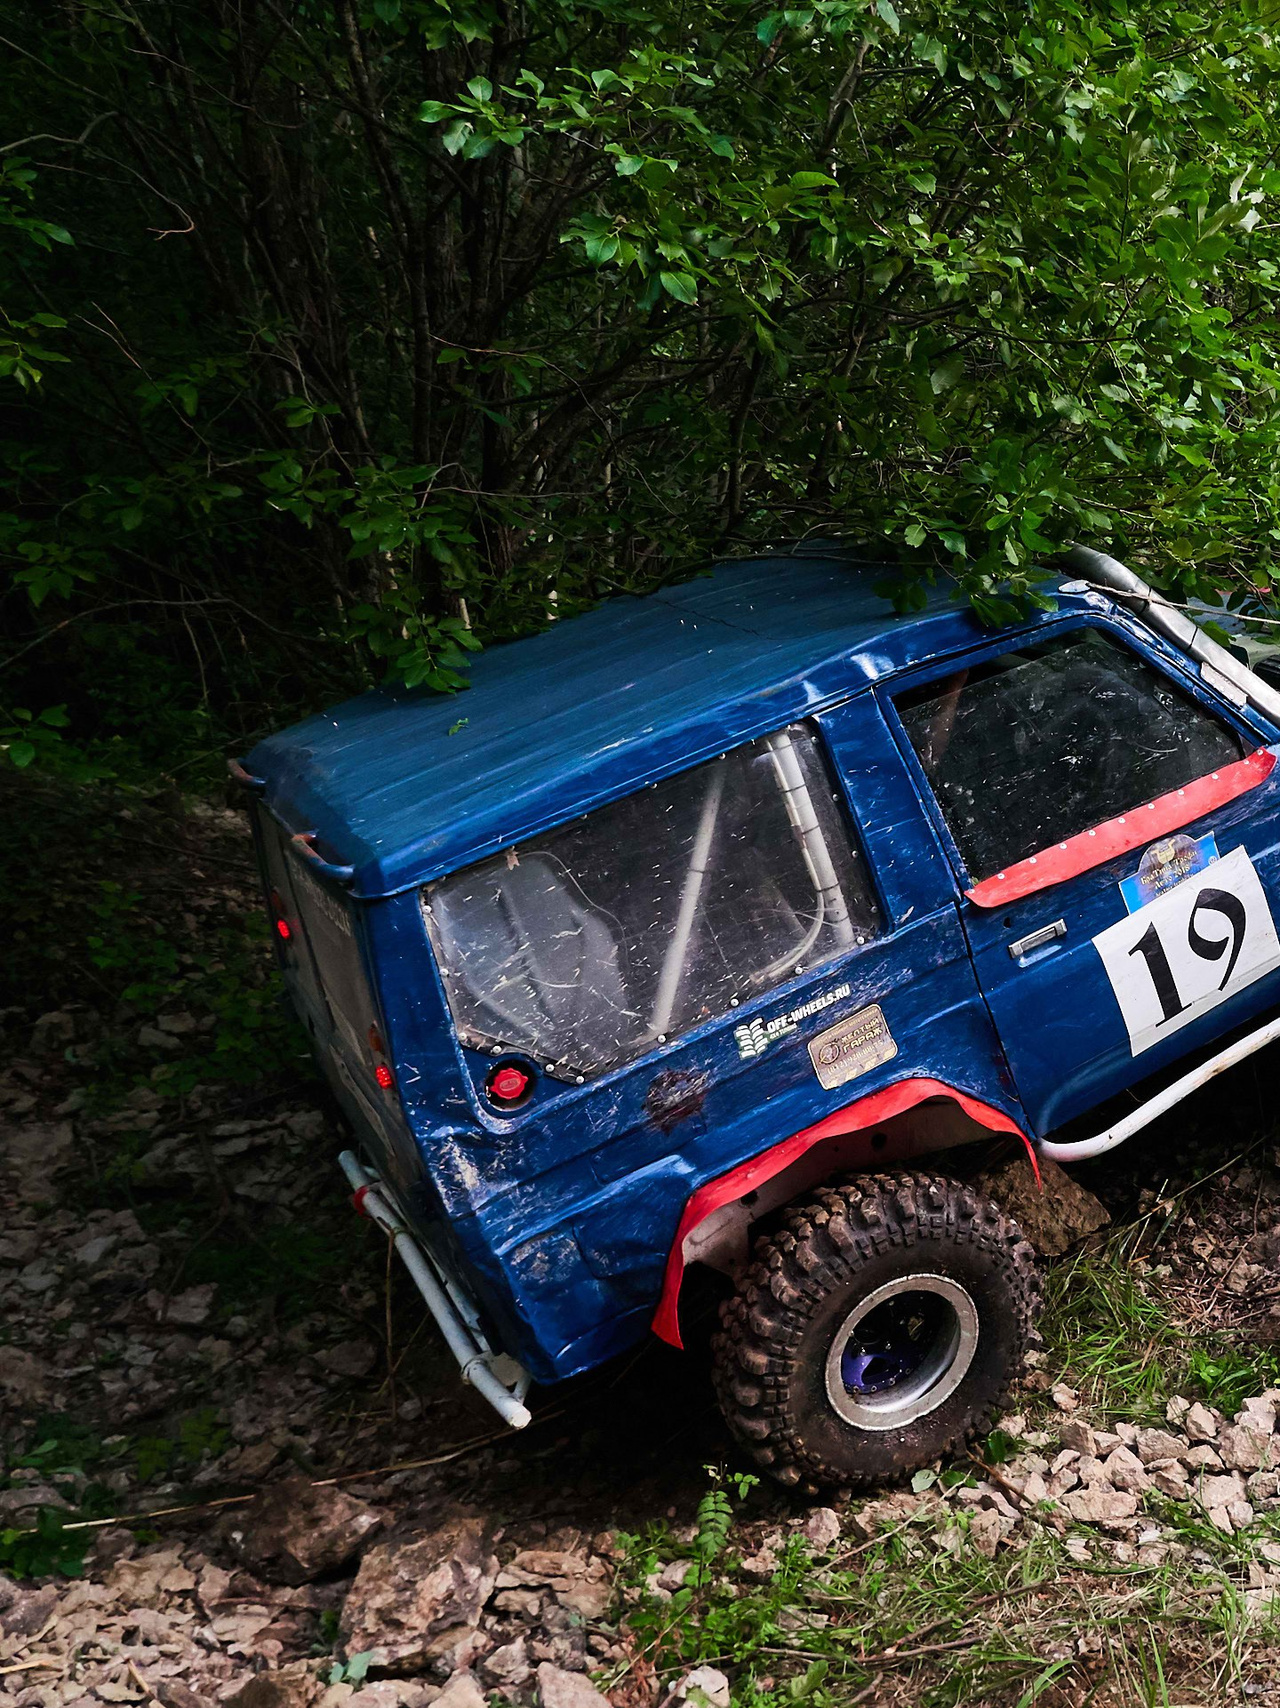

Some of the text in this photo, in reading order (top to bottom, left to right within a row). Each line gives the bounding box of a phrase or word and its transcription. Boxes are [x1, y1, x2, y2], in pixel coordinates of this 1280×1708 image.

[1128, 888, 1246, 1028] 19
[766, 983, 851, 1033] OFF-WHEELS.RU
[841, 1017, 880, 1044] ЖЕЛТЫЙ
[843, 1027, 883, 1054] ГАРАЖ
